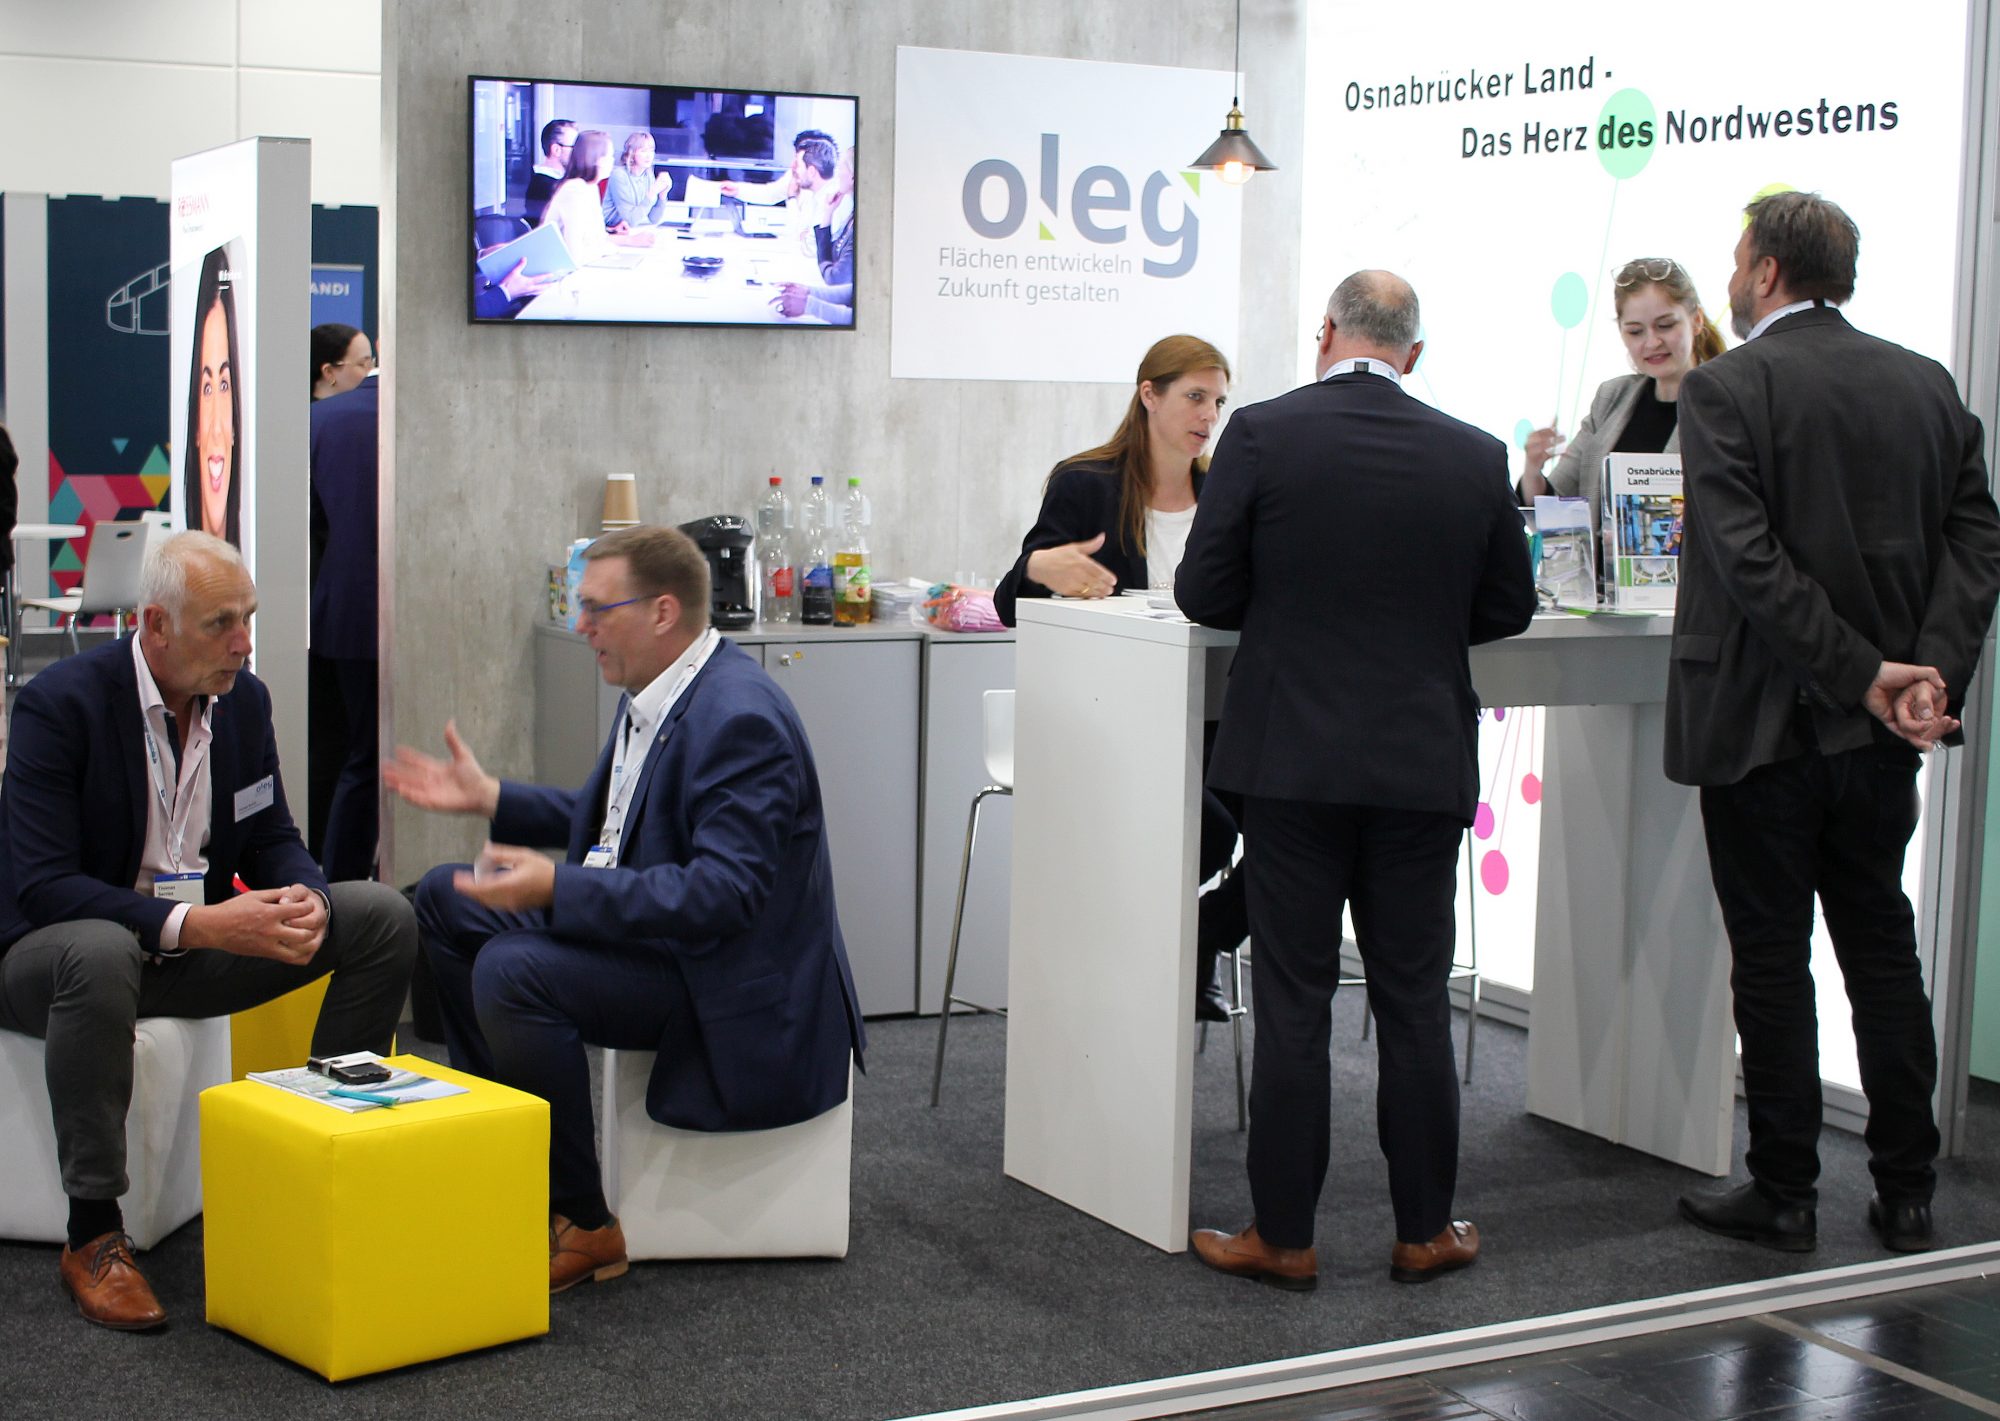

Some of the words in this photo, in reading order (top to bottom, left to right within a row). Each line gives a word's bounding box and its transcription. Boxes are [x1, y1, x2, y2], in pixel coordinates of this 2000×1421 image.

[1345, 69, 1514, 111] Osnabrücker
[1525, 56, 1594, 95] Land
[1461, 127, 1513, 158] Das
[1523, 121, 1588, 154] Herz
[1598, 115, 1655, 150] des
[1665, 98, 1899, 145] Nordwestens
[962, 132, 1200, 279] oleg
[939, 247, 1018, 270] Flächen
[1024, 252, 1132, 275] entwickeln
[938, 277, 1020, 300] Zukunft
[1026, 281, 1120, 305] gestalten
[1627, 477, 1650, 485] Land
